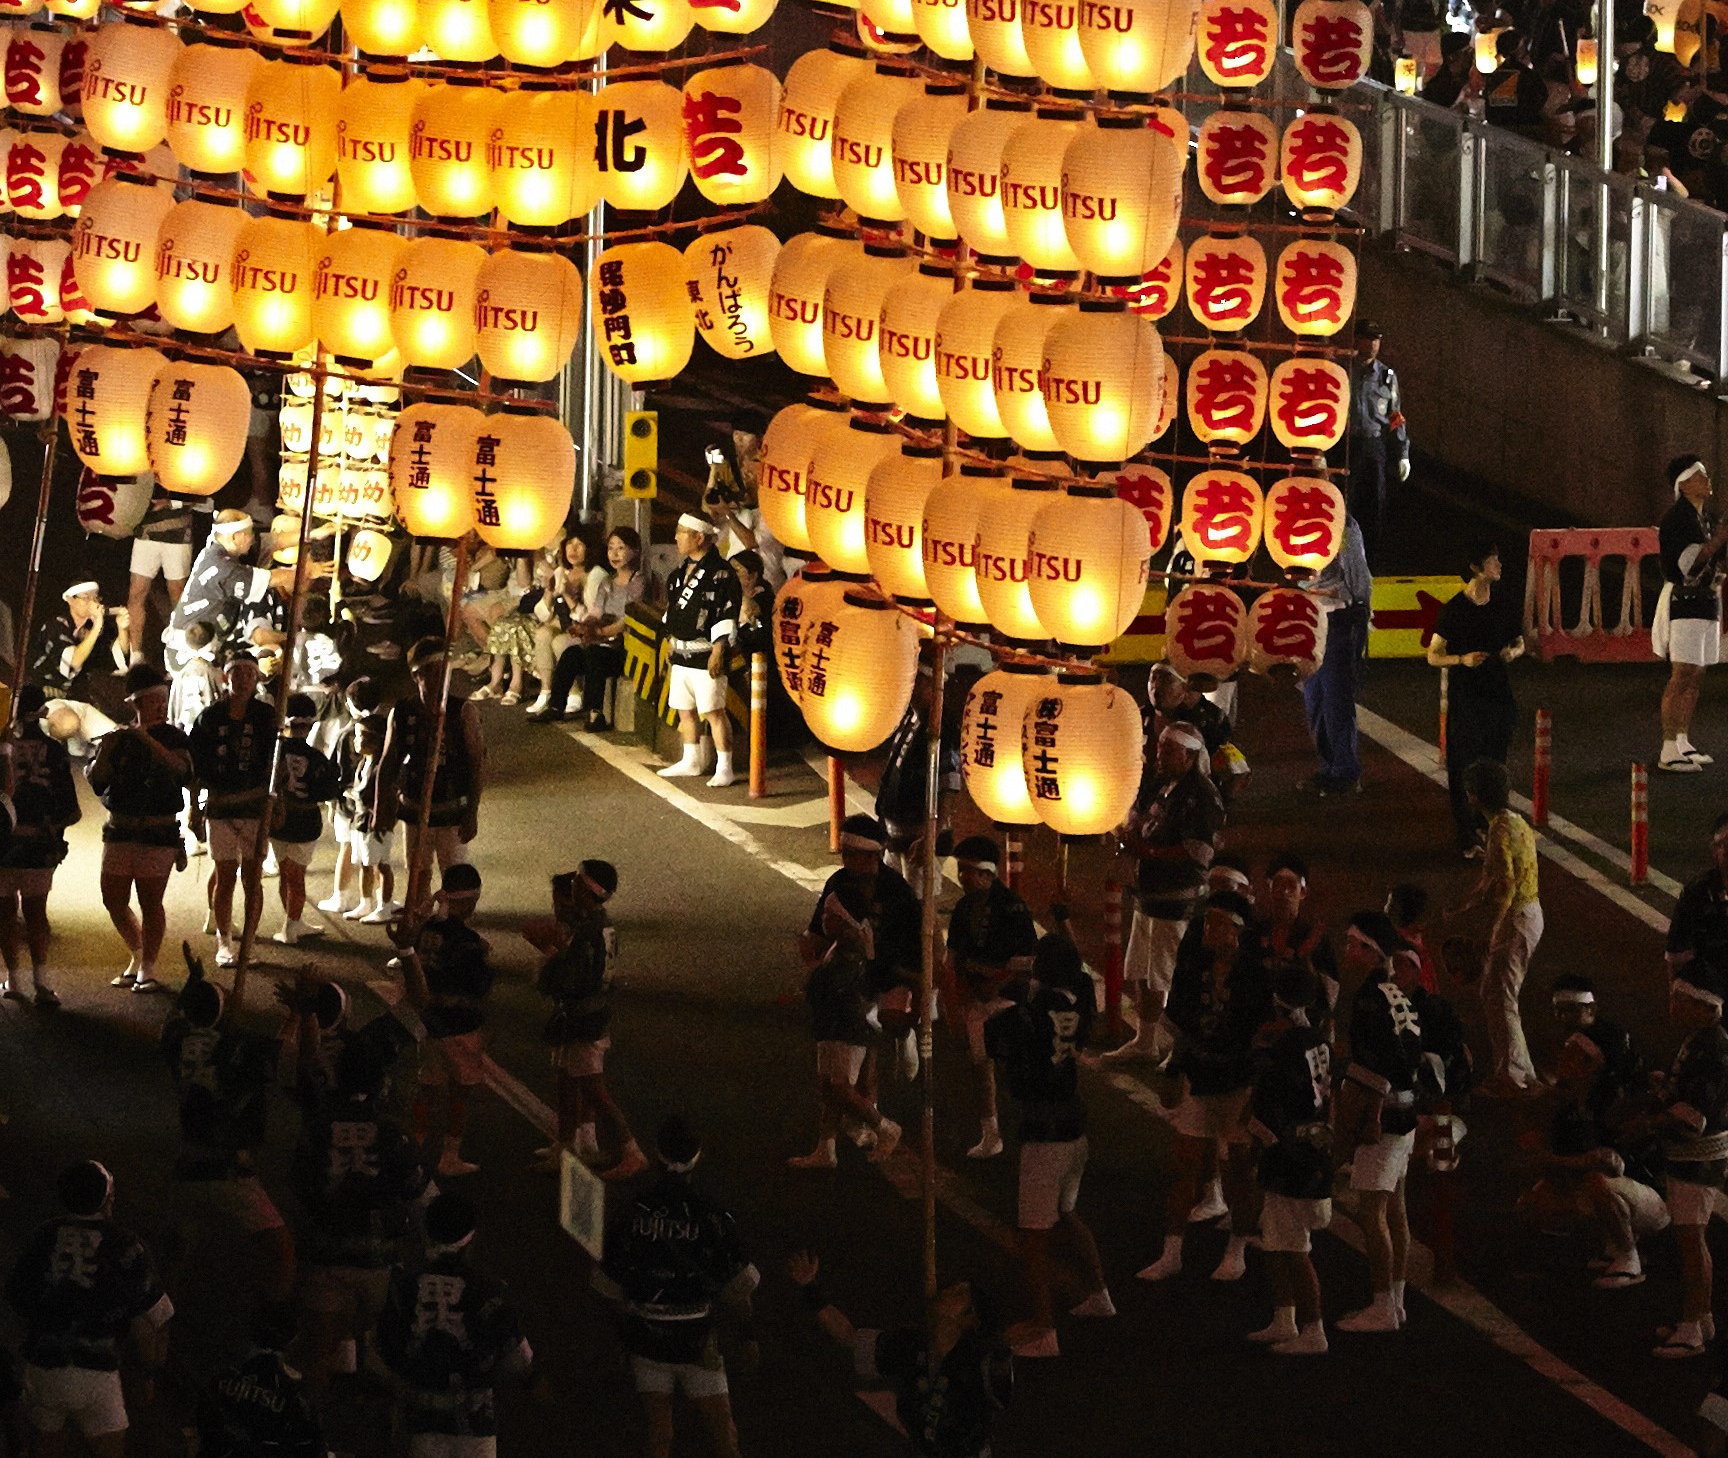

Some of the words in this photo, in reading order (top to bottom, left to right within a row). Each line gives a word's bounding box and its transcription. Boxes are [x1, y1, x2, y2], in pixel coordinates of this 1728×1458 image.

[686, 280, 714, 331] 東北
[710, 241, 754, 353] がんばろう
[75, 367, 101, 457] 富士通
[164, 378, 197, 447] 富士通
[408, 420, 437, 490] 富士通
[474, 435, 501, 527] 富士通
[806, 621, 839, 698] 富士通
[974, 690, 1004, 768] 富士通
